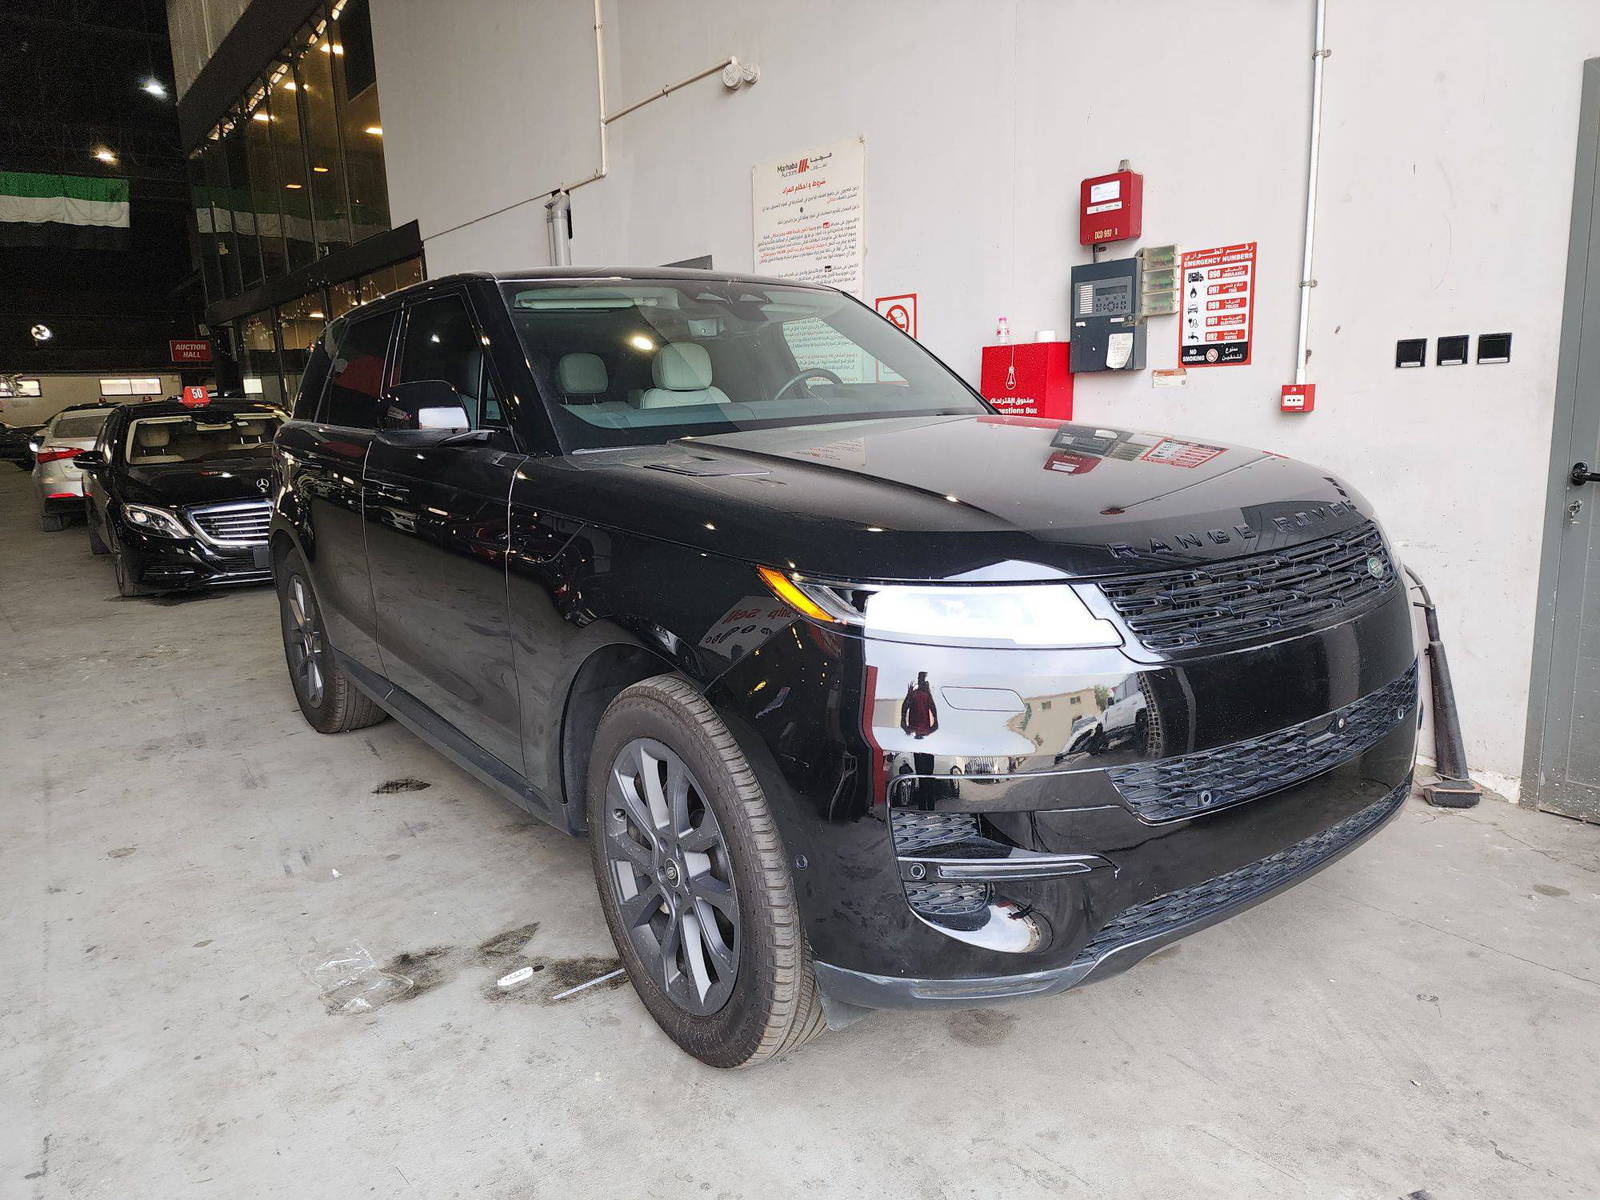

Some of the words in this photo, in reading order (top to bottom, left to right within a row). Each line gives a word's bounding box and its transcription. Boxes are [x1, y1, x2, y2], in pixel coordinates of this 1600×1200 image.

[1183, 256, 1221, 268] EMERGENCY
[1221, 252, 1253, 263] NUMBERS
[175, 343, 206, 351] AUCTION
[191, 388, 203, 399] 50
[1025, 407, 1038, 415] Box
[1104, 522, 1257, 560] RANGE
[1272, 500, 1358, 532] ROVER
